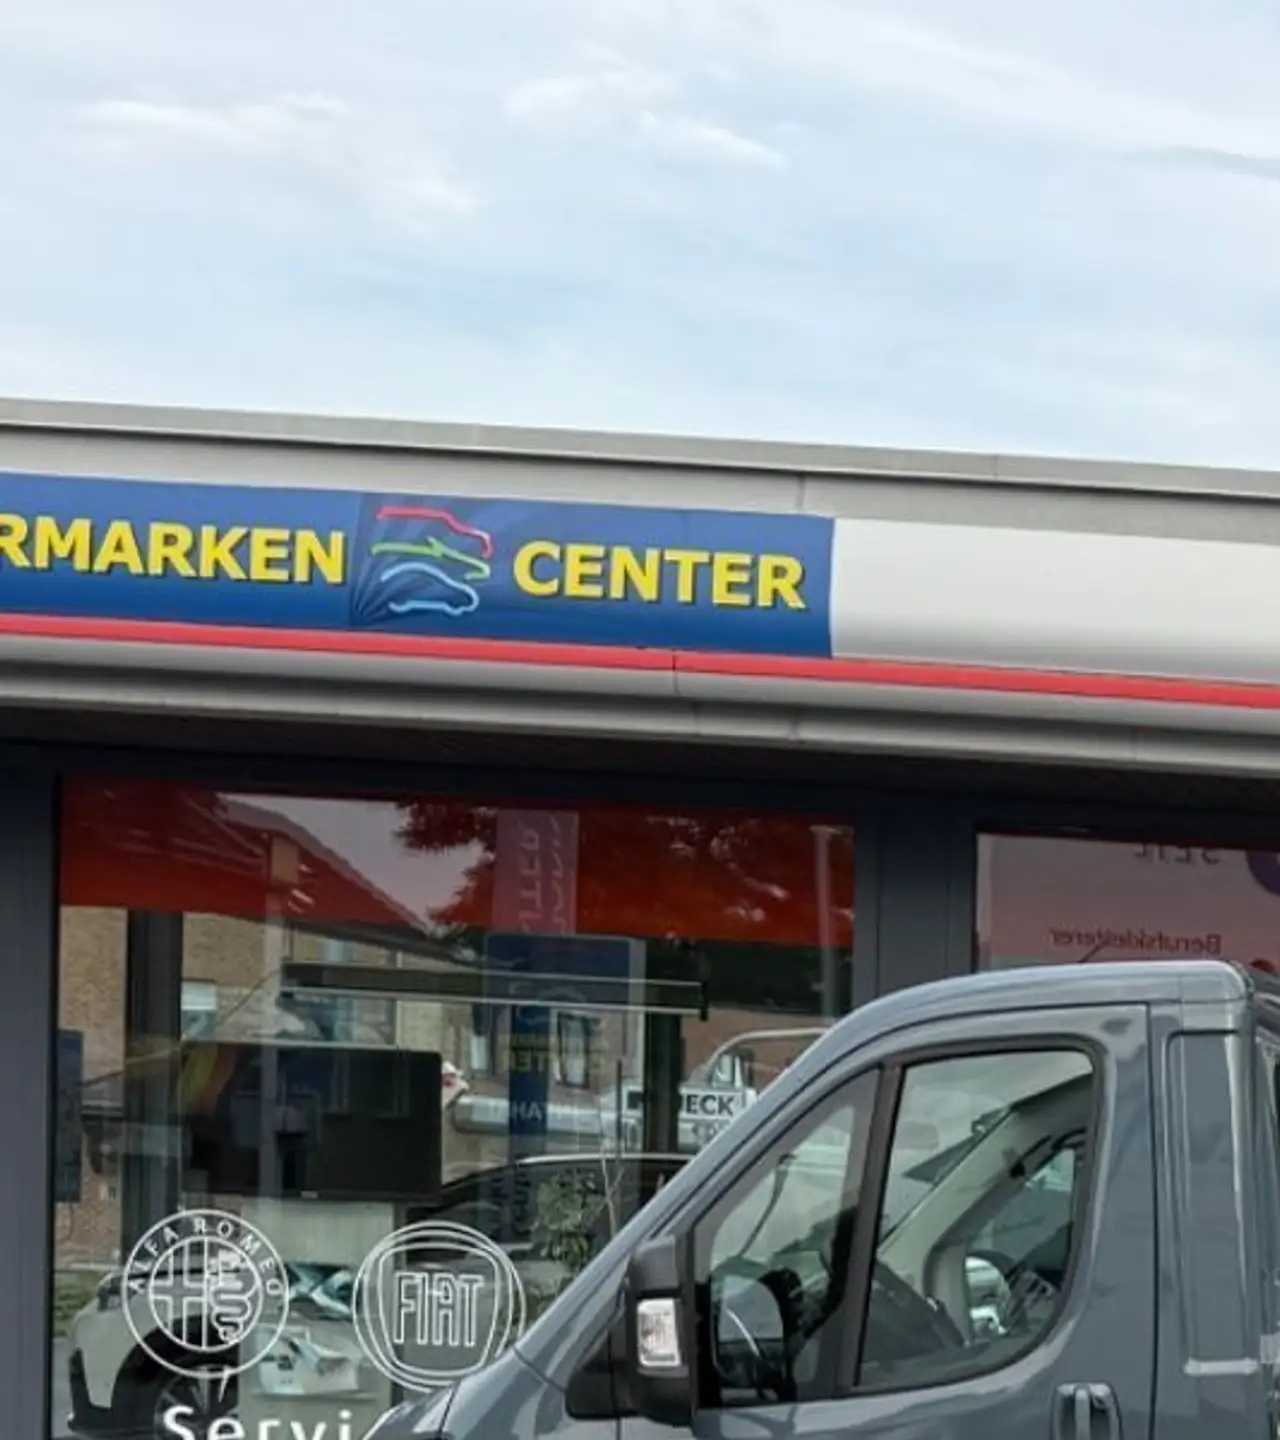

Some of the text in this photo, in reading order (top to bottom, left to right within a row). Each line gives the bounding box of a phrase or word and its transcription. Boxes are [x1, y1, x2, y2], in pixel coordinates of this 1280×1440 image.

[0, 512, 806, 610] RMARKEN CENTER
[126, 1217, 287, 1298] ALFA ROMEO
[393, 1271, 485, 1348] FIAT
